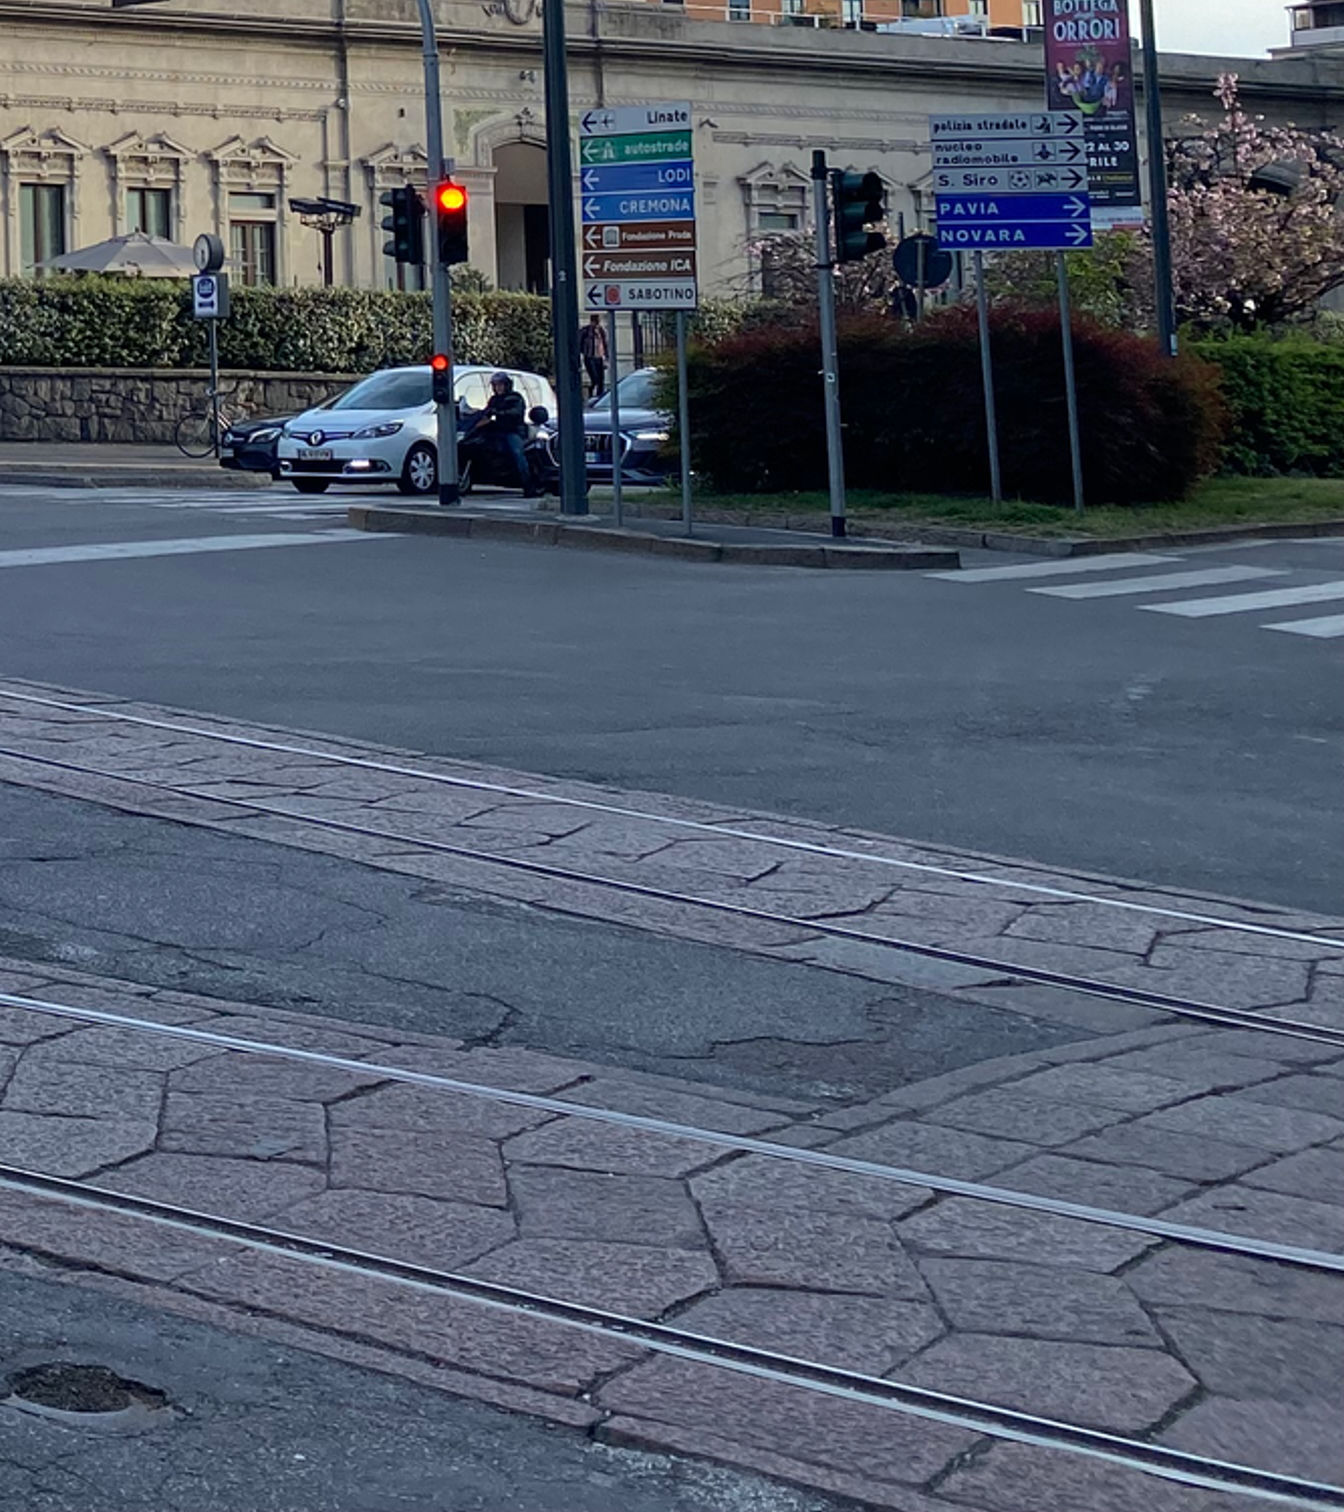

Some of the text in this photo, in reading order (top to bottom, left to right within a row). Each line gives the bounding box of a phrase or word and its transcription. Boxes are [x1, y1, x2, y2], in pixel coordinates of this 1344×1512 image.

[1053, 18, 1120, 41] ORRORI
[647, 109, 688, 124] Linate
[933, 118, 1027, 134] polizia stradale
[624, 139, 689, 155] autostrade
[935, 142, 982, 152] nucleo
[1098, 143, 1111, 152] AL
[1114, 141, 1130, 151] 30
[936, 153, 1019, 164] radiomobile
[658, 168, 690, 183] LODI
[938, 173, 999, 187] S. Siro
[619, 198, 691, 214] CREMONA
[939, 202, 999, 215] PAVIA
[622, 231, 666, 242] Fondazione
[940, 229, 1025, 242] NOVARA
[602, 258, 692, 272] Fondazione ICA
[628, 287, 694, 300] SABOTINO
